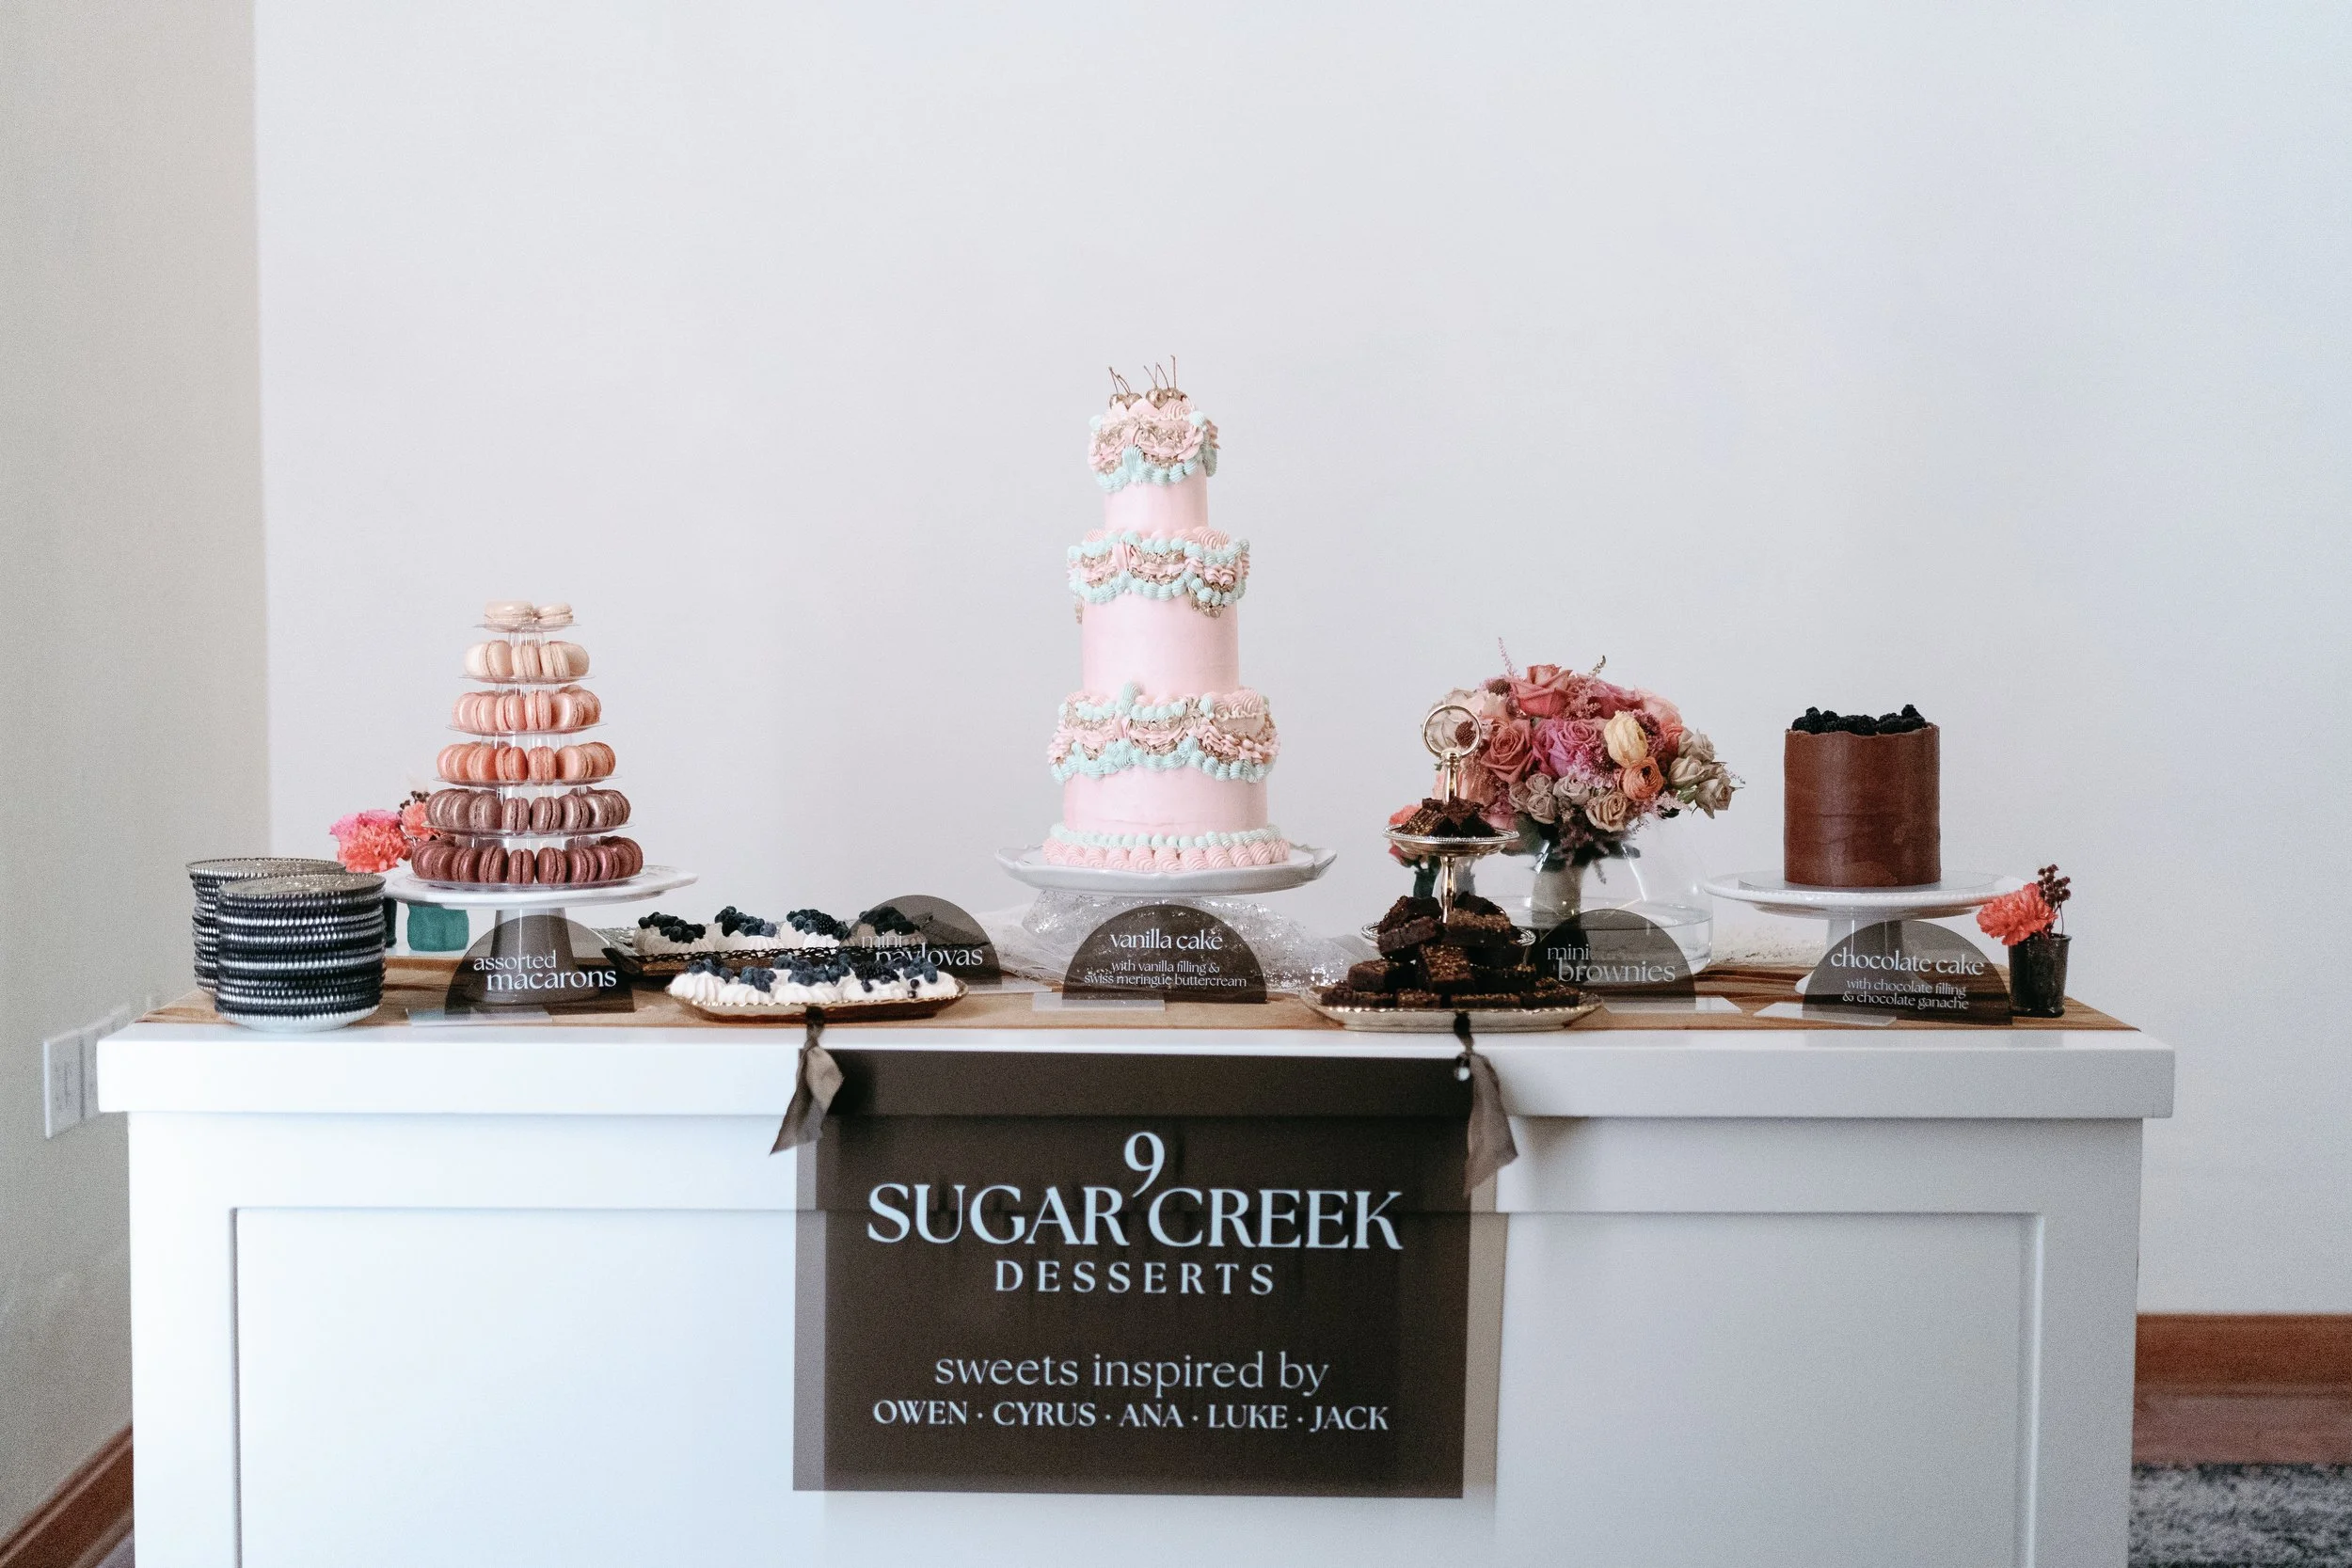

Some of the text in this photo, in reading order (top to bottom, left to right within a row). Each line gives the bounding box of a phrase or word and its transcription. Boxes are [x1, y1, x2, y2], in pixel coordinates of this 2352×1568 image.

[862, 931, 902, 948] mini
[1110, 928, 1223, 950] vanilla cake
[474, 950, 557, 971] assorted
[1548, 944, 1590, 960] mini
[1831, 946, 1984, 975] chocolate cake
[1112, 960, 1219, 975] with vanilla filling &
[1558, 958, 1676, 983] brownies
[486, 969, 616, 991] macarons
[1084, 974, 1247, 988] swiss meringue buttercream
[1847, 978, 1966, 999] with chocolate filling
[1842, 991, 1969, 1010] & chocolate ganache
[1123, 1132, 1165, 1198] 9
[867, 1182, 1404, 1250] SUGAR CREEK
[995, 1259, 1275, 1296] DESSERTS
[935, 1351, 1330, 1399] sweets inspired by
[872, 1399, 1390, 1433] OWEN CYRUS ANA LUKE JACK
